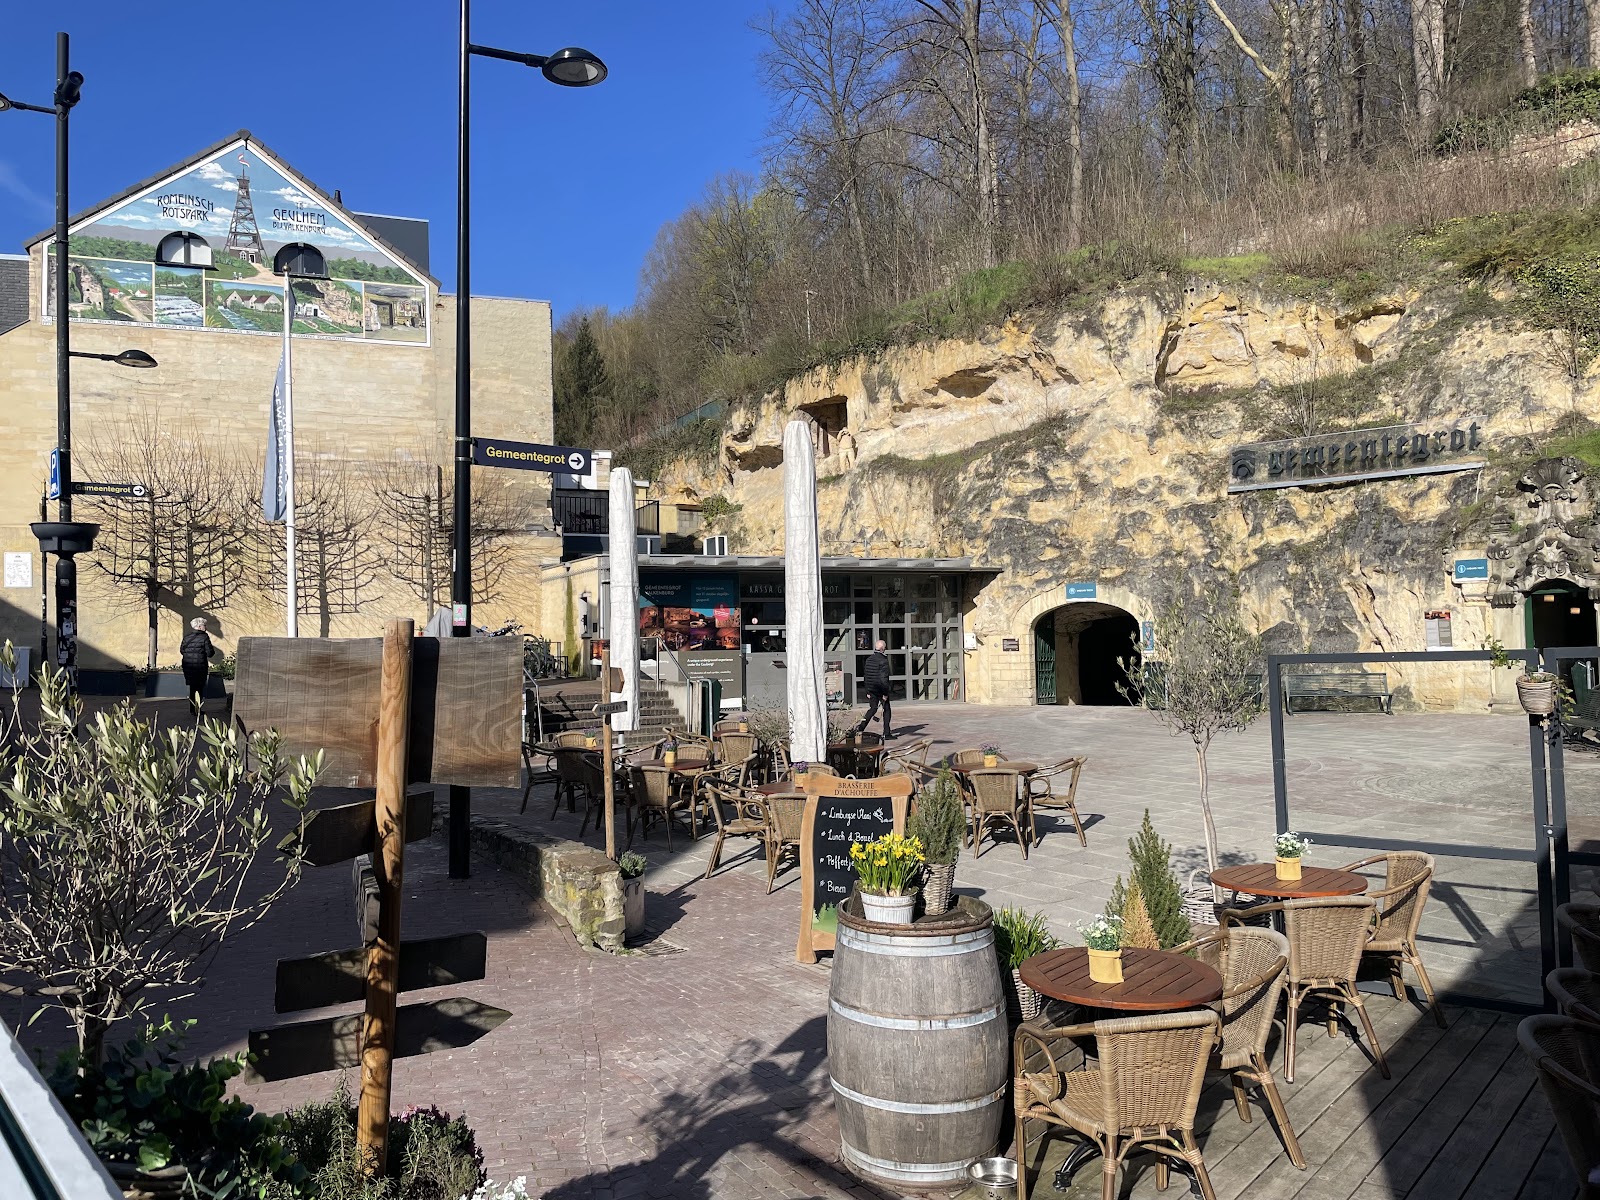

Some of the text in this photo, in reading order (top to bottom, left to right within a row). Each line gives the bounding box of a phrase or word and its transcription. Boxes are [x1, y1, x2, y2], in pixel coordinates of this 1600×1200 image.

[157, 193, 214, 212] ROMEINSCH
[162, 206, 209, 221] ROTSPARK
[273, 208, 326, 225] GEULHEM
[485, 446, 566, 465] Gemeentegrot
[1267, 421, 1483, 475] gemeentegrot
[51, 453, 57, 478] P
[75, 484, 131, 494] Gemeentegrot
[749, 585, 776, 594] KASSA
[838, 782, 875, 790] BRASSERIE
[827, 828, 846, 841] Lunch
[826, 854, 855, 871] Poffertje
